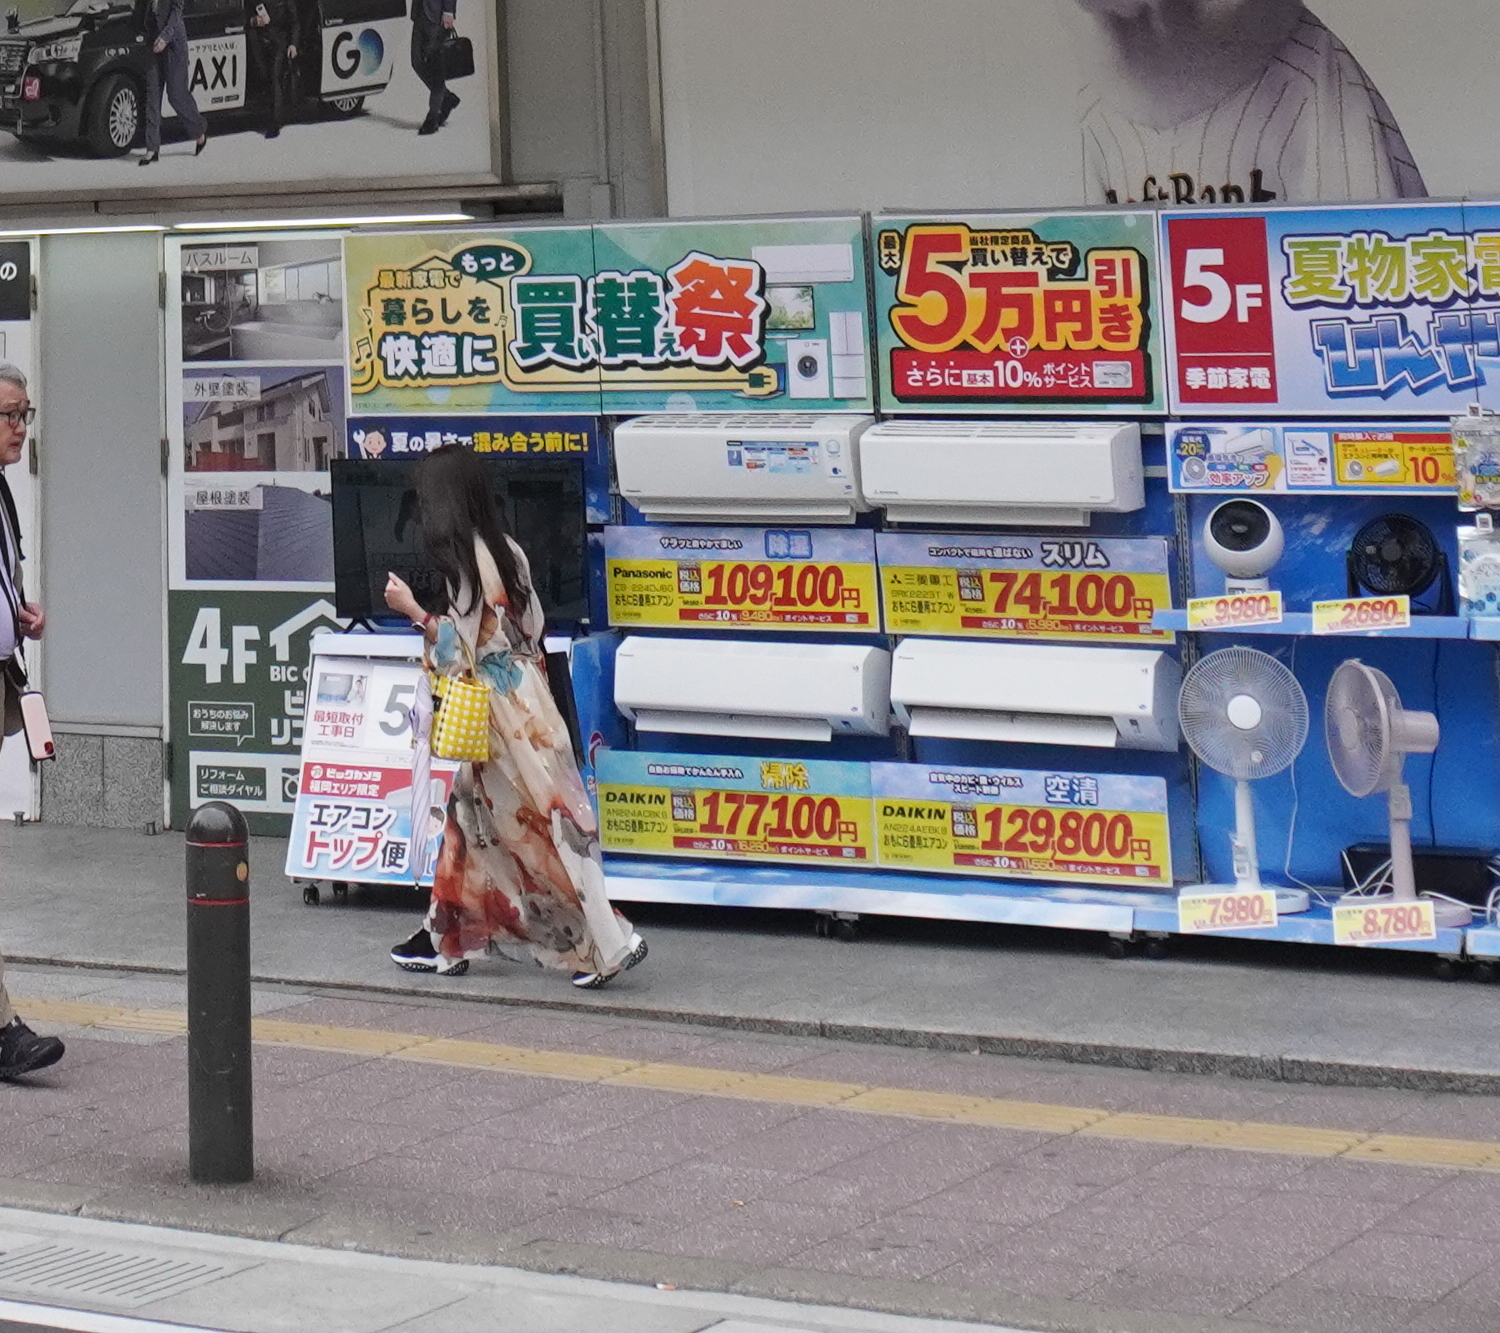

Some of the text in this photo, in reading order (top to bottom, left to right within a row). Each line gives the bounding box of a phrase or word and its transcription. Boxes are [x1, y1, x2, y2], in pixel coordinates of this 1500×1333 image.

[970, 235, 1031, 246] 当社指定商品
[185, 250, 254, 270] バスルーム
[883, 234, 898, 269] 最大
[971, 246, 1070, 267] 買い替えで
[461, 252, 515, 274] もっと
[379, 270, 461, 290] 最新家電で
[1180, 249, 1264, 324] 5F
[381, 297, 492, 325] 暮らしを
[381, 335, 497, 375] 快適に
[1186, 366, 1271, 391] 季節家電
[192, 380, 250, 398] 外壁塗装
[1207, 471, 1270, 487] 効率アップ
[195, 489, 251, 507] 屋根塗装
[1040, 542, 1110, 568] スリム
[613, 568, 672, 579] Panasonic
[182, 608, 261, 684] 4F
[270, 665, 299, 682] BIC
[313, 710, 364, 724] 最短取付
[318, 724, 355, 738] 工事日
[200, 770, 245, 781] リフォーム
[760, 762, 810, 789] 掃除
[199, 785, 264, 797] ご相談ダイヤル
[310, 782, 380, 796] 福岡エリア限定
[606, 791, 666, 805] DAIKIN
[1045, 776, 1098, 804] 空清
[310, 804, 396, 830] エアコン
[882, 805, 946, 820] DAIKIN
[305, 830, 407, 870] トップ便
